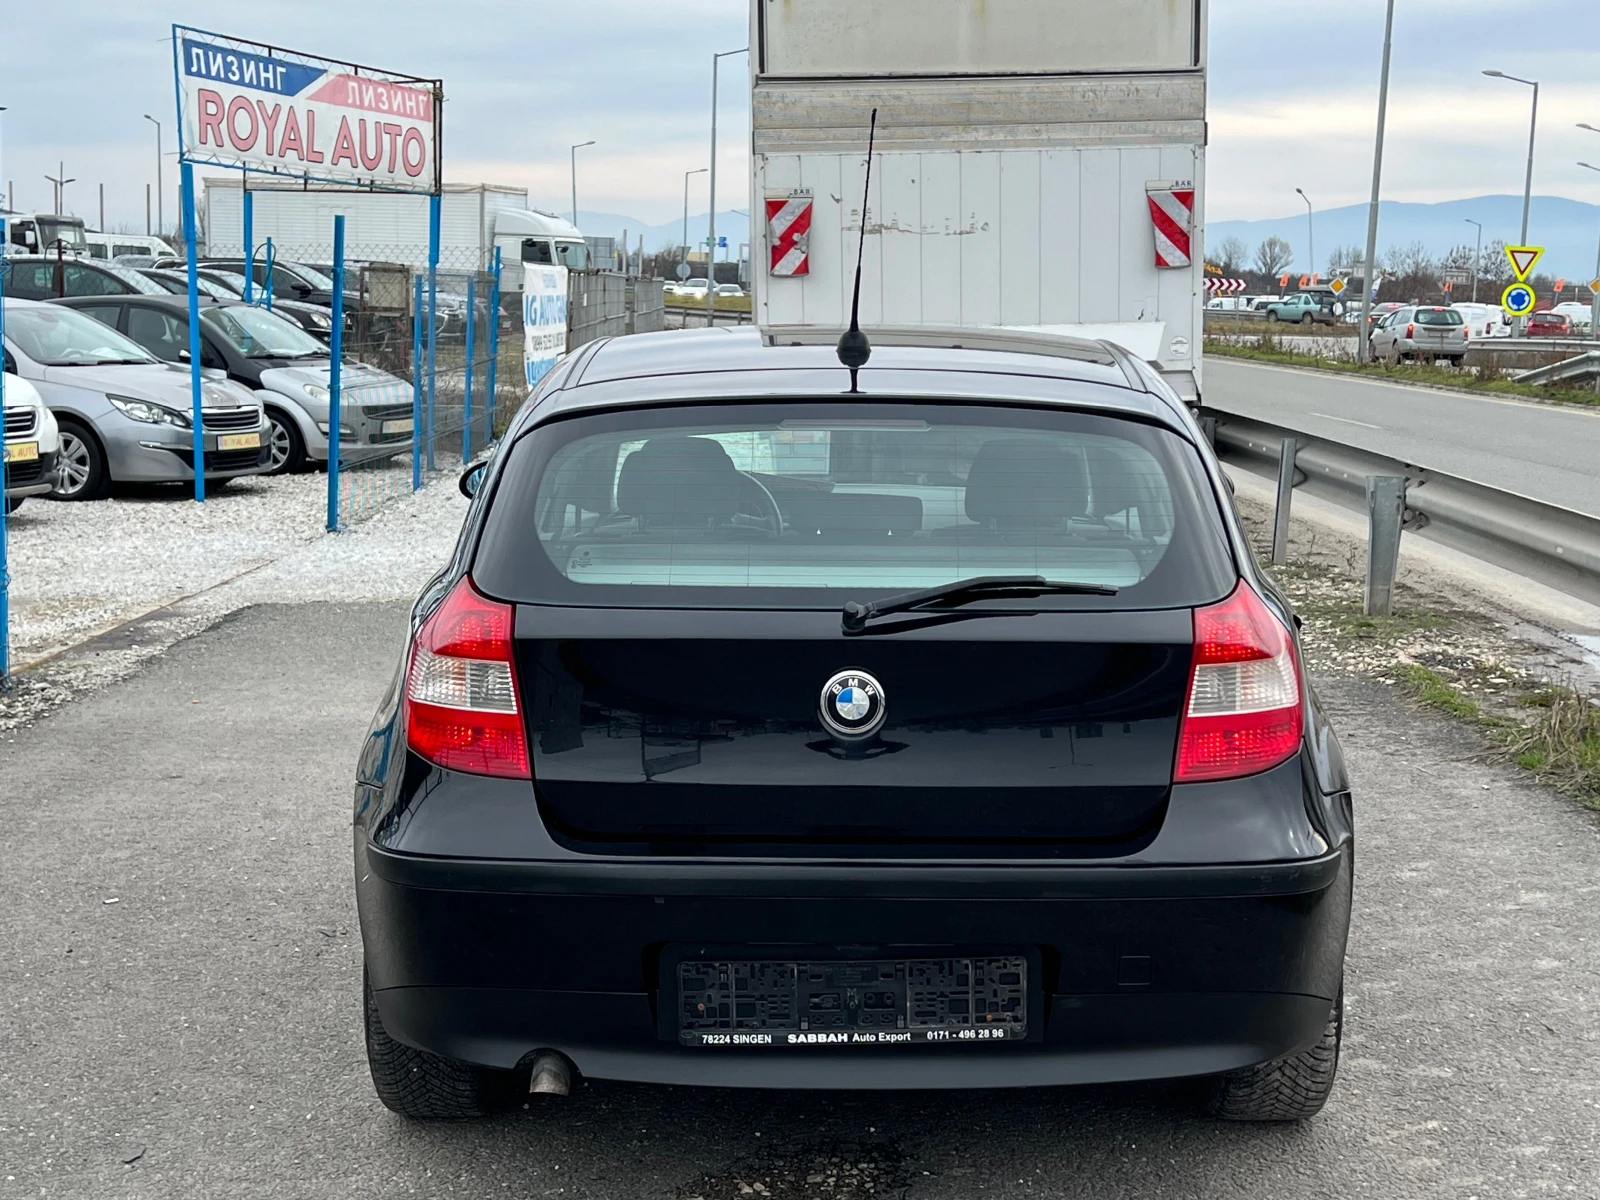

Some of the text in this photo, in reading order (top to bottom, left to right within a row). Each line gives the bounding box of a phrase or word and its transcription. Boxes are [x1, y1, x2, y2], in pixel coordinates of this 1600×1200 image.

[191, 47, 286, 91] ЛИЗИНГ
[347, 81, 427, 117] ЛИЗИНГ
[198, 88, 426, 178] ROYAL AUTO
[18, 446, 37, 458] AUTO
[832, 678, 875, 695] BMW
[702, 1034, 731, 1044] 78224
[732, 1034, 772, 1044] SINGEN
[787, 1033, 848, 1043] SABBAH
[852, 1033, 876, 1042] Auto
[878, 1032, 911, 1043] Export
[927, 1031, 949, 1040] 0171
[958, 1030, 976, 1039] 496
[978, 1029, 989, 1038] 28
[992, 1029, 1004, 1038] 96
